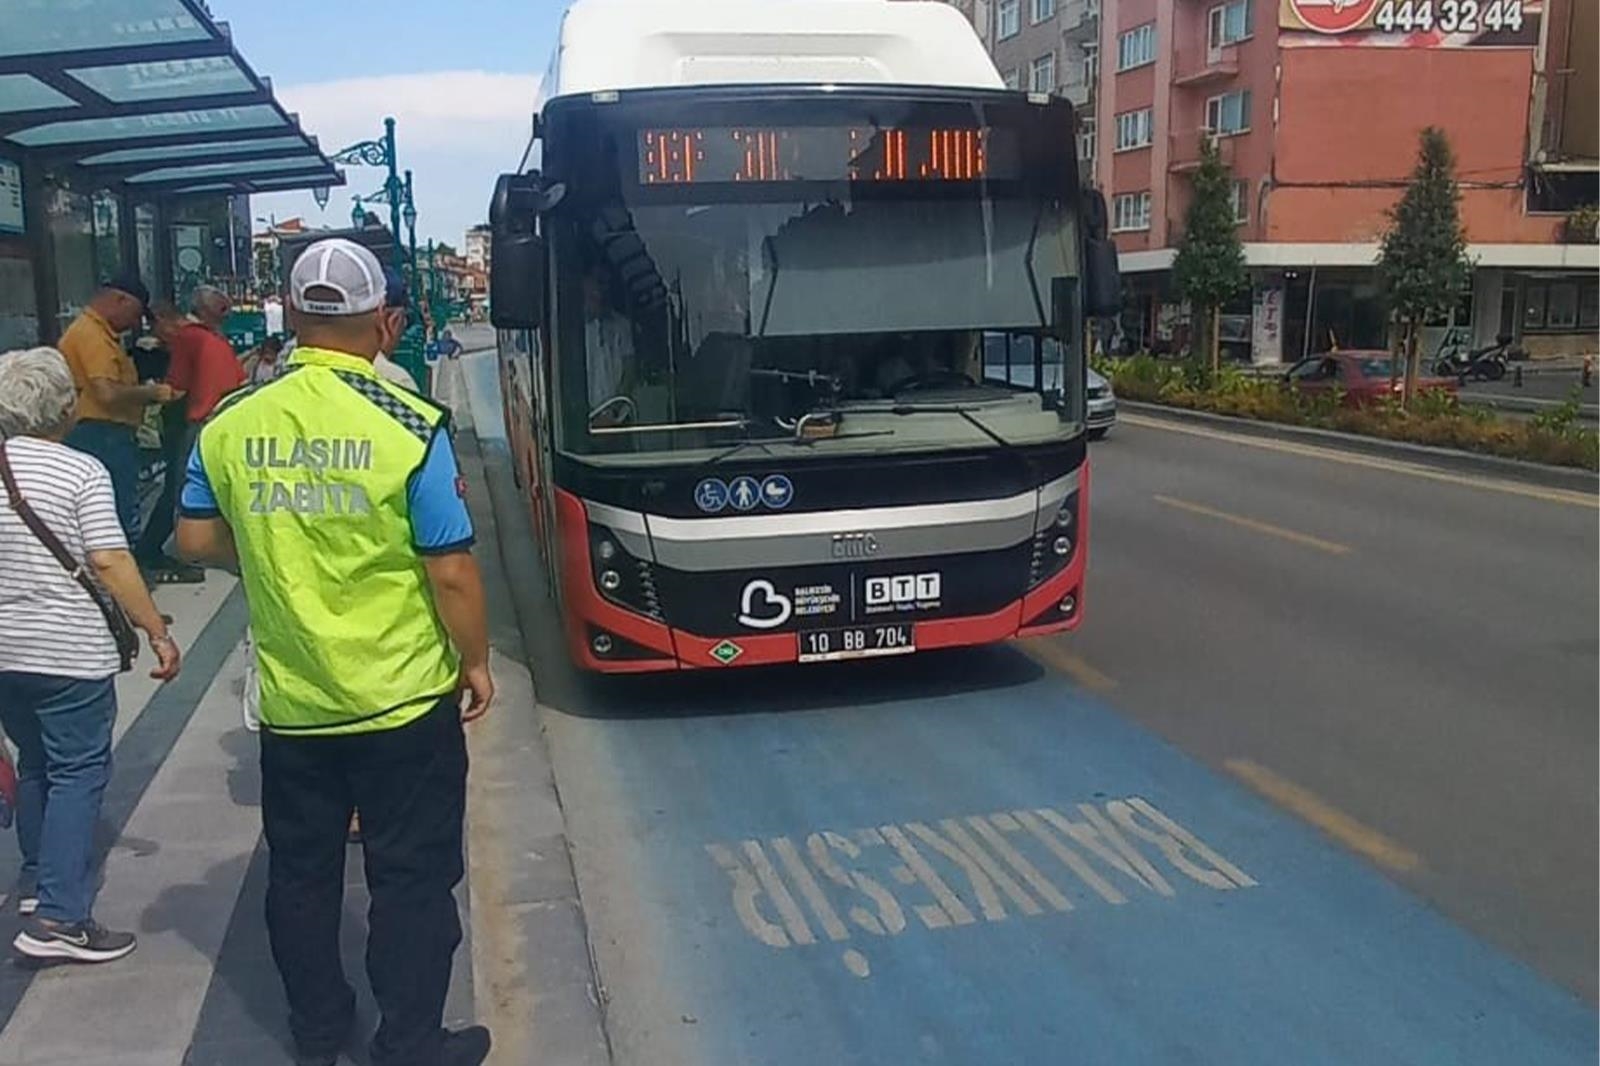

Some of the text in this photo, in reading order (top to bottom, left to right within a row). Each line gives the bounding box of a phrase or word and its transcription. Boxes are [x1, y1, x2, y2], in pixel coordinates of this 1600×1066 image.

[1375, 0, 1523, 31] 444 32 44
[245, 437, 372, 478] ULAŞIM
[249, 481, 370, 514] ZABITA
[867, 574, 938, 603] BTT
[809, 627, 906, 653] 10 BB 704
